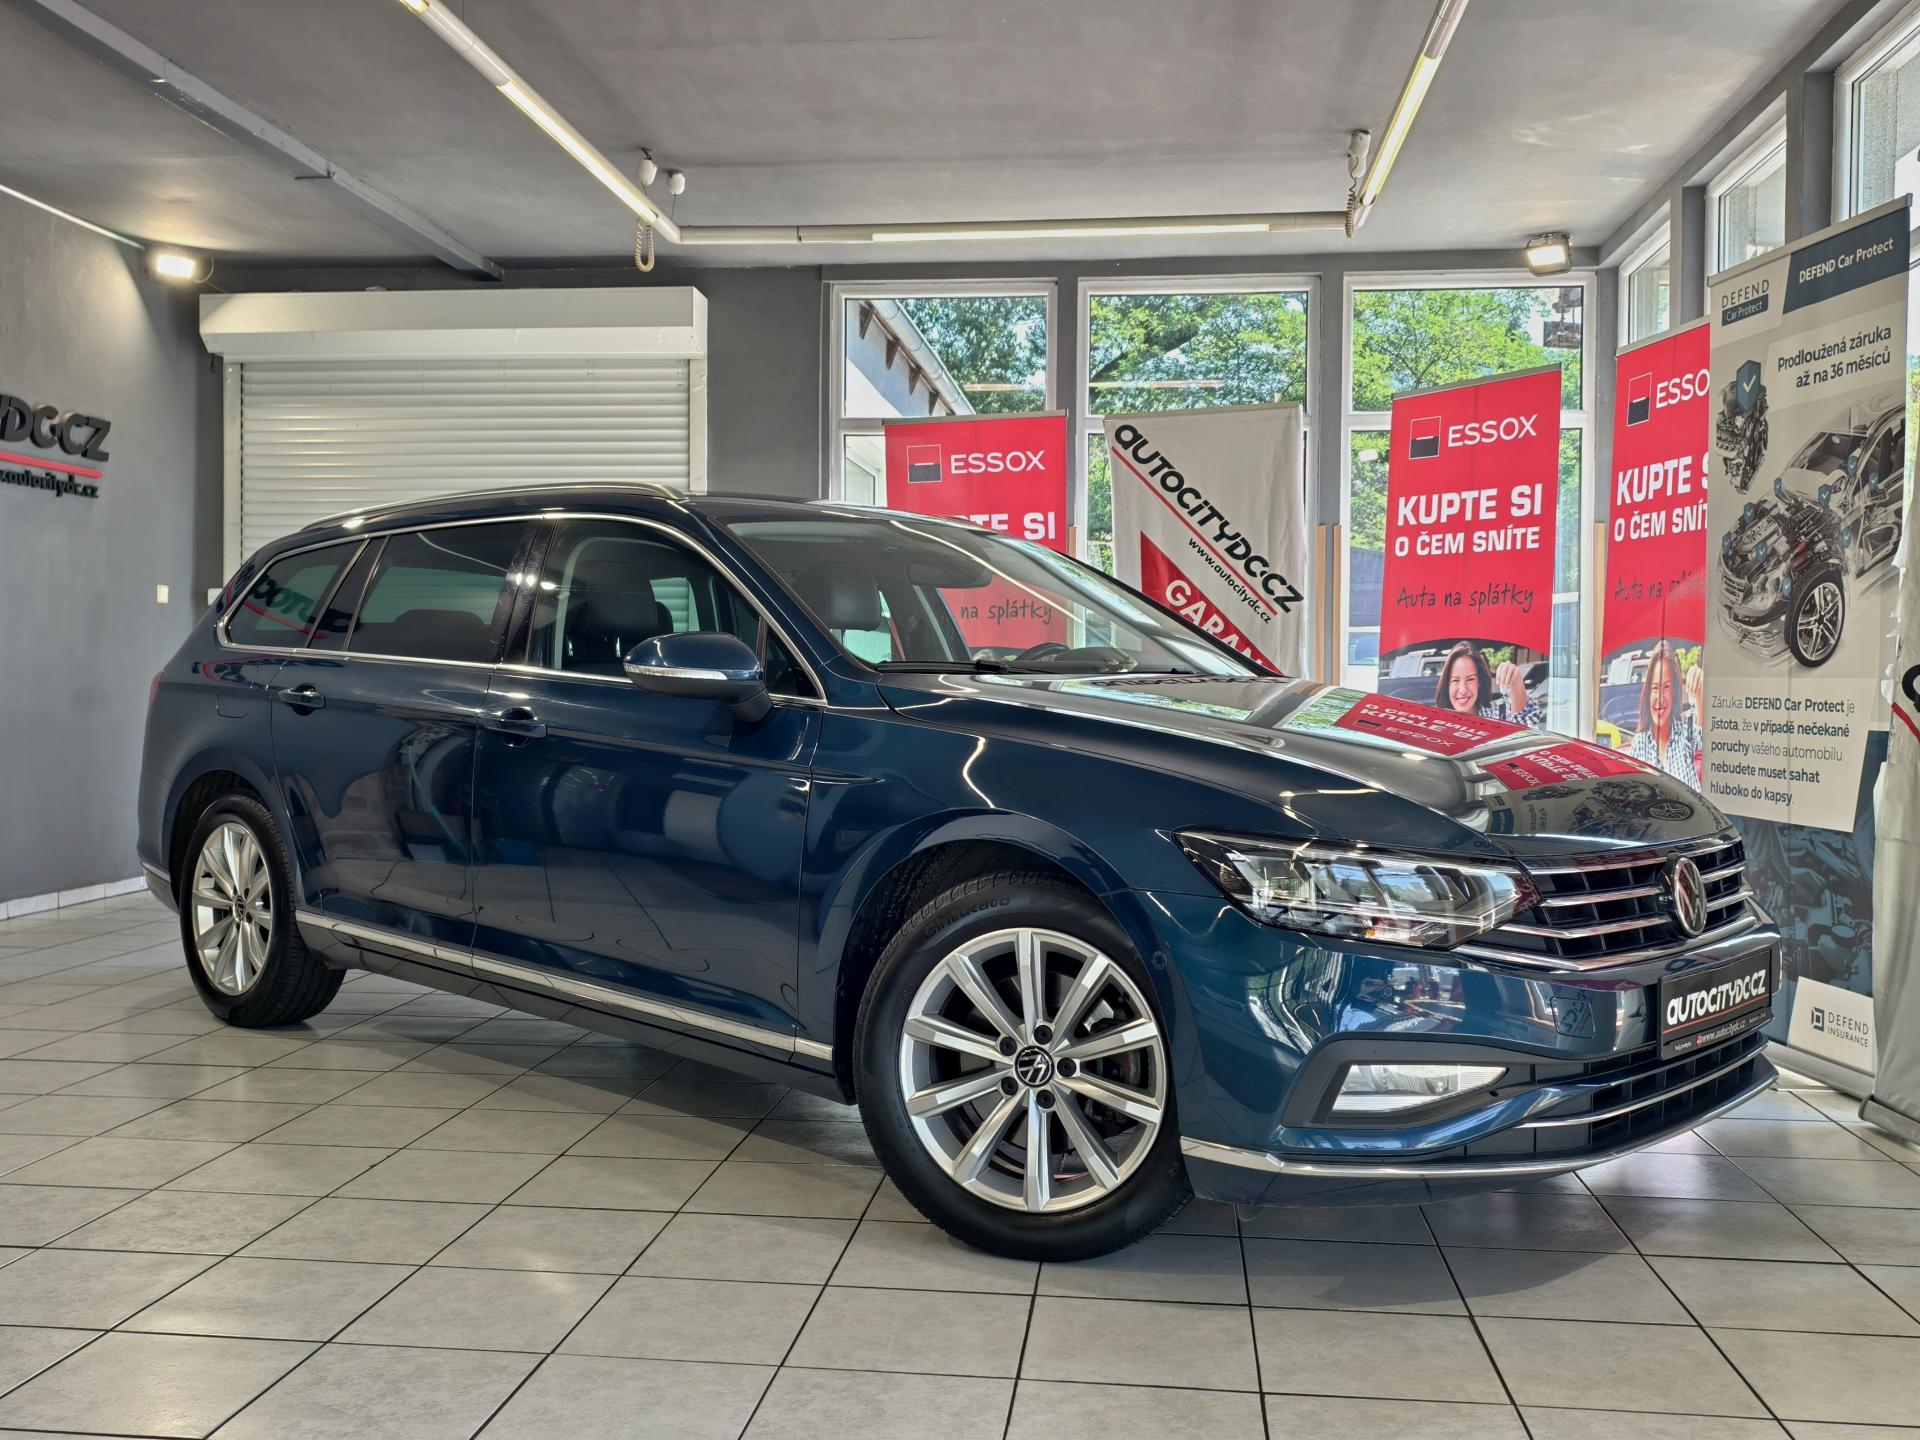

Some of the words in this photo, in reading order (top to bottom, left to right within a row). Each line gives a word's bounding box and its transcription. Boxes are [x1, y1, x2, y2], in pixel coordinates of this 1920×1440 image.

[1799, 259, 1836, 284] DEFEND
[1837, 252, 1854, 269] Car
[1856, 237, 1894, 263] Protect
[1722, 279, 1770, 308] DEFEND
[1726, 310, 1738, 322] Car
[1738, 301, 1762, 319] Protect
[1777, 336, 1847, 372] Prodloužená
[1849, 325, 1891, 349] záruka
[1796, 368, 1810, 388] až
[1813, 368, 1829, 384] na
[1830, 362, 1844, 379] 36
[1846, 345, 1891, 374] měsíců
[1656, 368, 1710, 409] ESSO
[1447, 414, 1538, 447] ESSOX
[950, 450, 1046, 475] ESSOX
[1616, 455, 1693, 506] KUPTE
[1397, 488, 1498, 527] KUPTE
[1510, 483, 1543, 517] SI
[1614, 517, 1626, 542] O
[1629, 510, 1667, 540] ČEM
[1671, 498, 1708, 534] SNÍ
[1023, 511, 1056, 541] SI
[1394, 536, 1410, 558] O
[1416, 529, 1465, 556] ČEM
[1472, 523, 1541, 554] SNÍTE
[1188, 537, 1272, 625] www.autocitydc.cz
[960, 606, 979, 619] na
[988, 599, 1052, 625] splátky
[1396, 584, 1437, 608] Auta
[1444, 593, 1462, 606] na
[1469, 582, 1534, 614] splátky
[1165, 579, 1263, 665] GARA
[1712, 696, 1743, 709] Záruka
[1745, 696, 1782, 711] DEFEND
[1784, 698, 1802, 711] Car
[1804, 699, 1845, 713] Protect
[1845, 700, 1855, 717] je
[1742, 720, 1752, 732] že
[1760, 720, 1795, 736] případě
[1797, 722, 1850, 738] nečekané
[1711, 741, 1750, 756] poruchy
[1751, 742, 1781, 756] vašeho
[1782, 746, 1843, 762] automobilu
[1710, 761, 1756, 777] nebudete
[1758, 766, 1787, 780] muset
[1789, 768, 1821, 784] sahat
[1710, 781, 1749, 798] hluboko
[1751, 786, 1763, 799] do
[1827, 1026, 1869, 1048] INSURANCE
[1828, 1011, 1869, 1035] DEFEND
